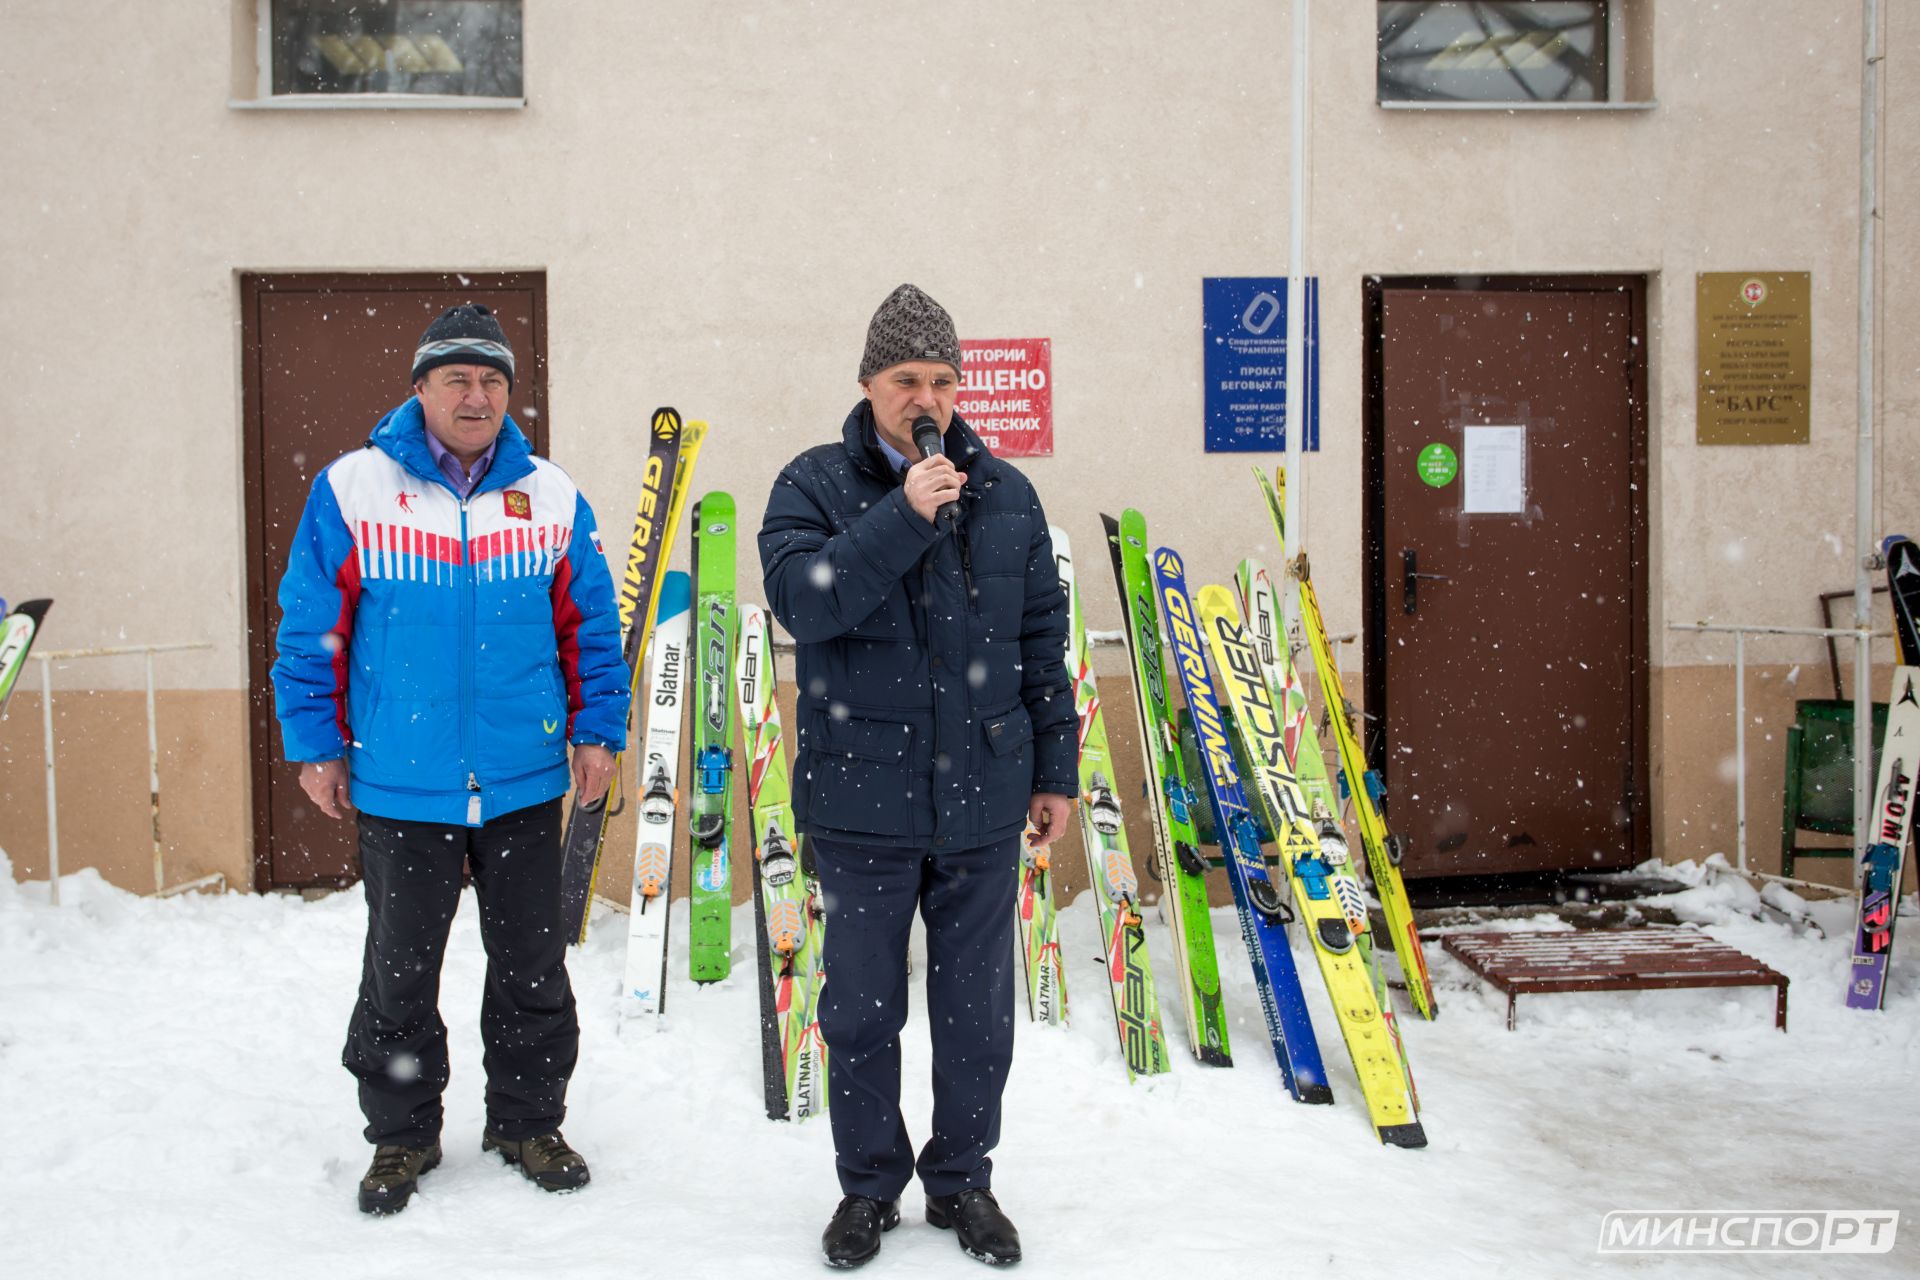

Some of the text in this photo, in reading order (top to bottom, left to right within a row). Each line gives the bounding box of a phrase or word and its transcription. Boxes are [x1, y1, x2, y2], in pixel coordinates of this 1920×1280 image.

[961, 349, 1026, 362] ИТОРИИ
[1240, 366, 1284, 376] ПРОКАТ
[957, 369, 1046, 395] ЕЩЕНО
[1221, 380, 1272, 391] БЕГОВЫХ
[1260, 403, 1287, 411] РАБОТ
[619, 455, 664, 625] GERMIN
[655, 643, 680, 708] Slatnar
[740, 634, 758, 704] elan
[1216, 616, 1311, 821] FISCHER
[798, 1051, 811, 1117] SLATNAR
